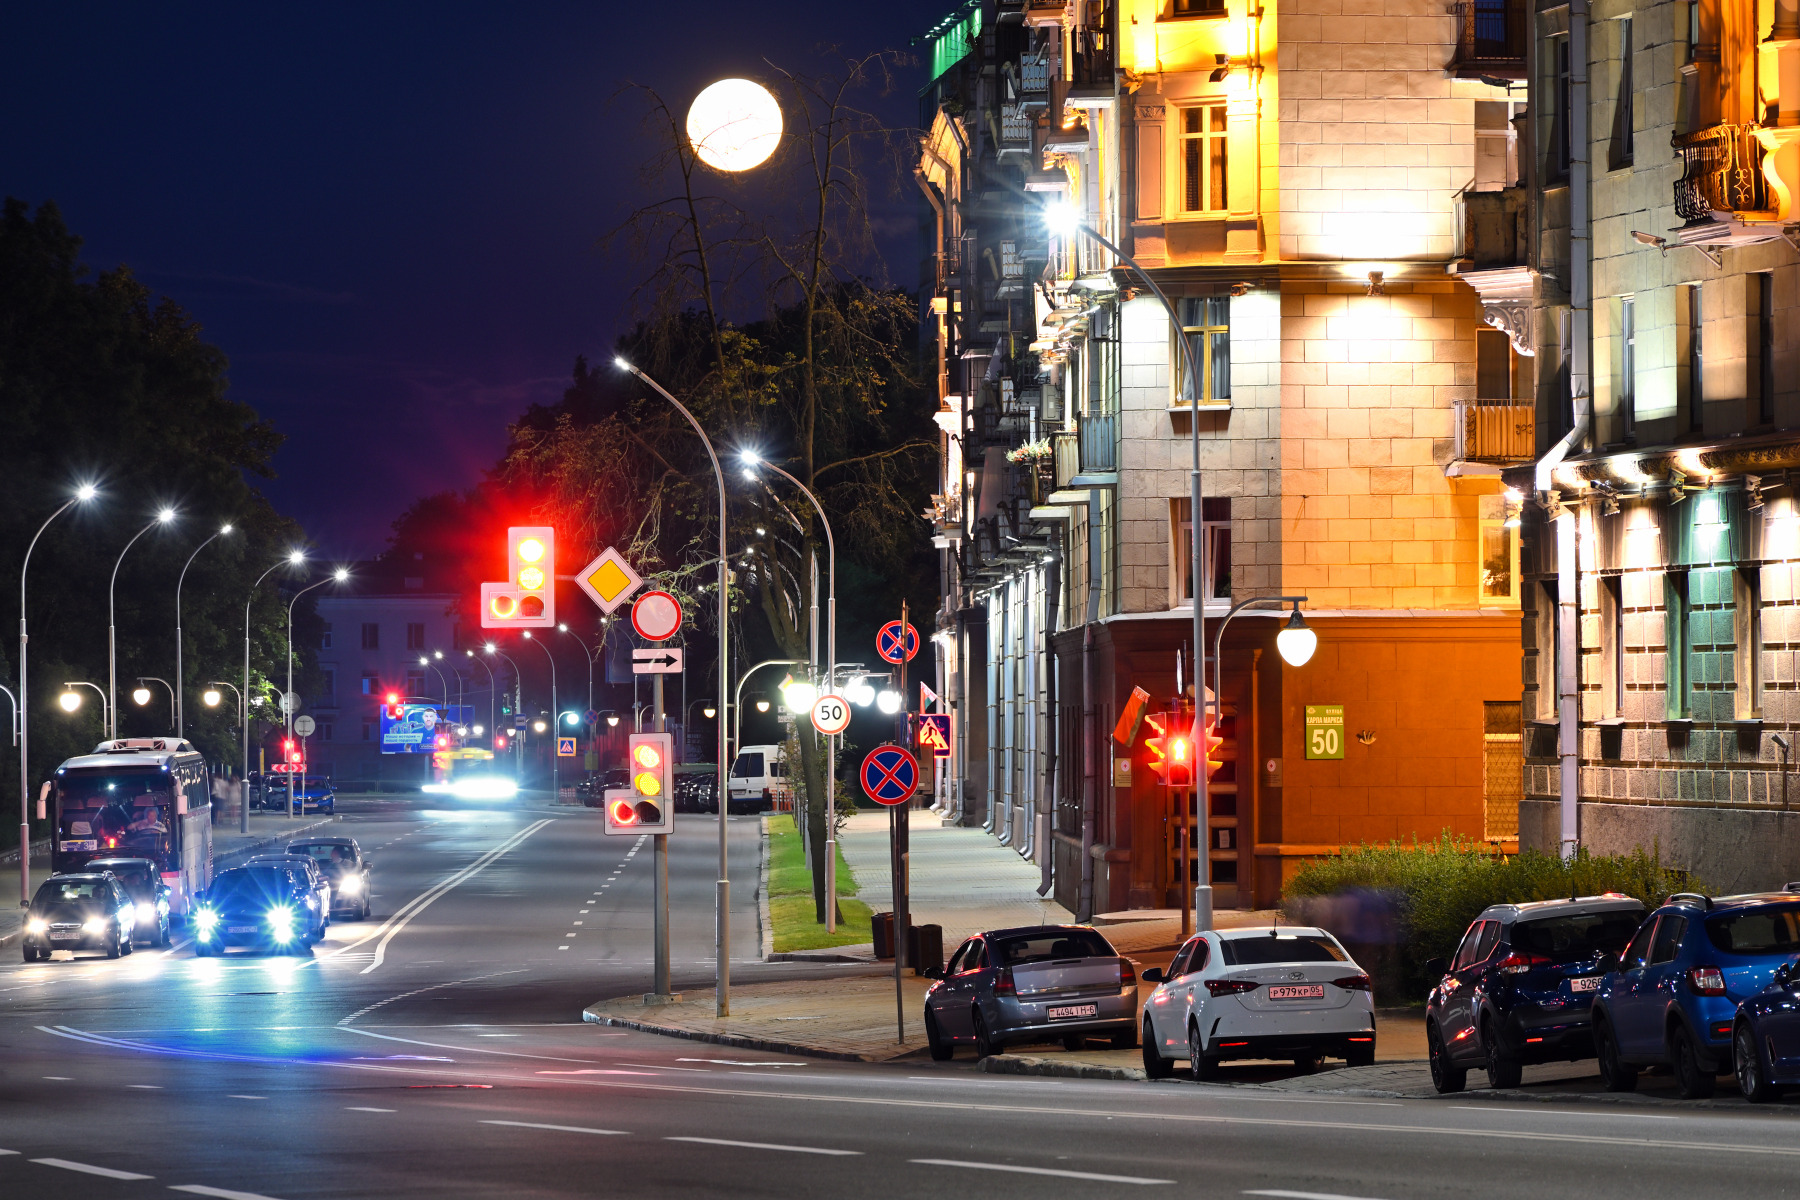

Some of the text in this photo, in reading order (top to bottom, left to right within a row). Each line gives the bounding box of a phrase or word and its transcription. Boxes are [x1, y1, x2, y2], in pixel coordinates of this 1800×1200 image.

[821, 705, 842, 720] 50
[1306, 716, 1343, 724] КАРЛА МАРКСА
[1311, 728, 1339, 755] 50
